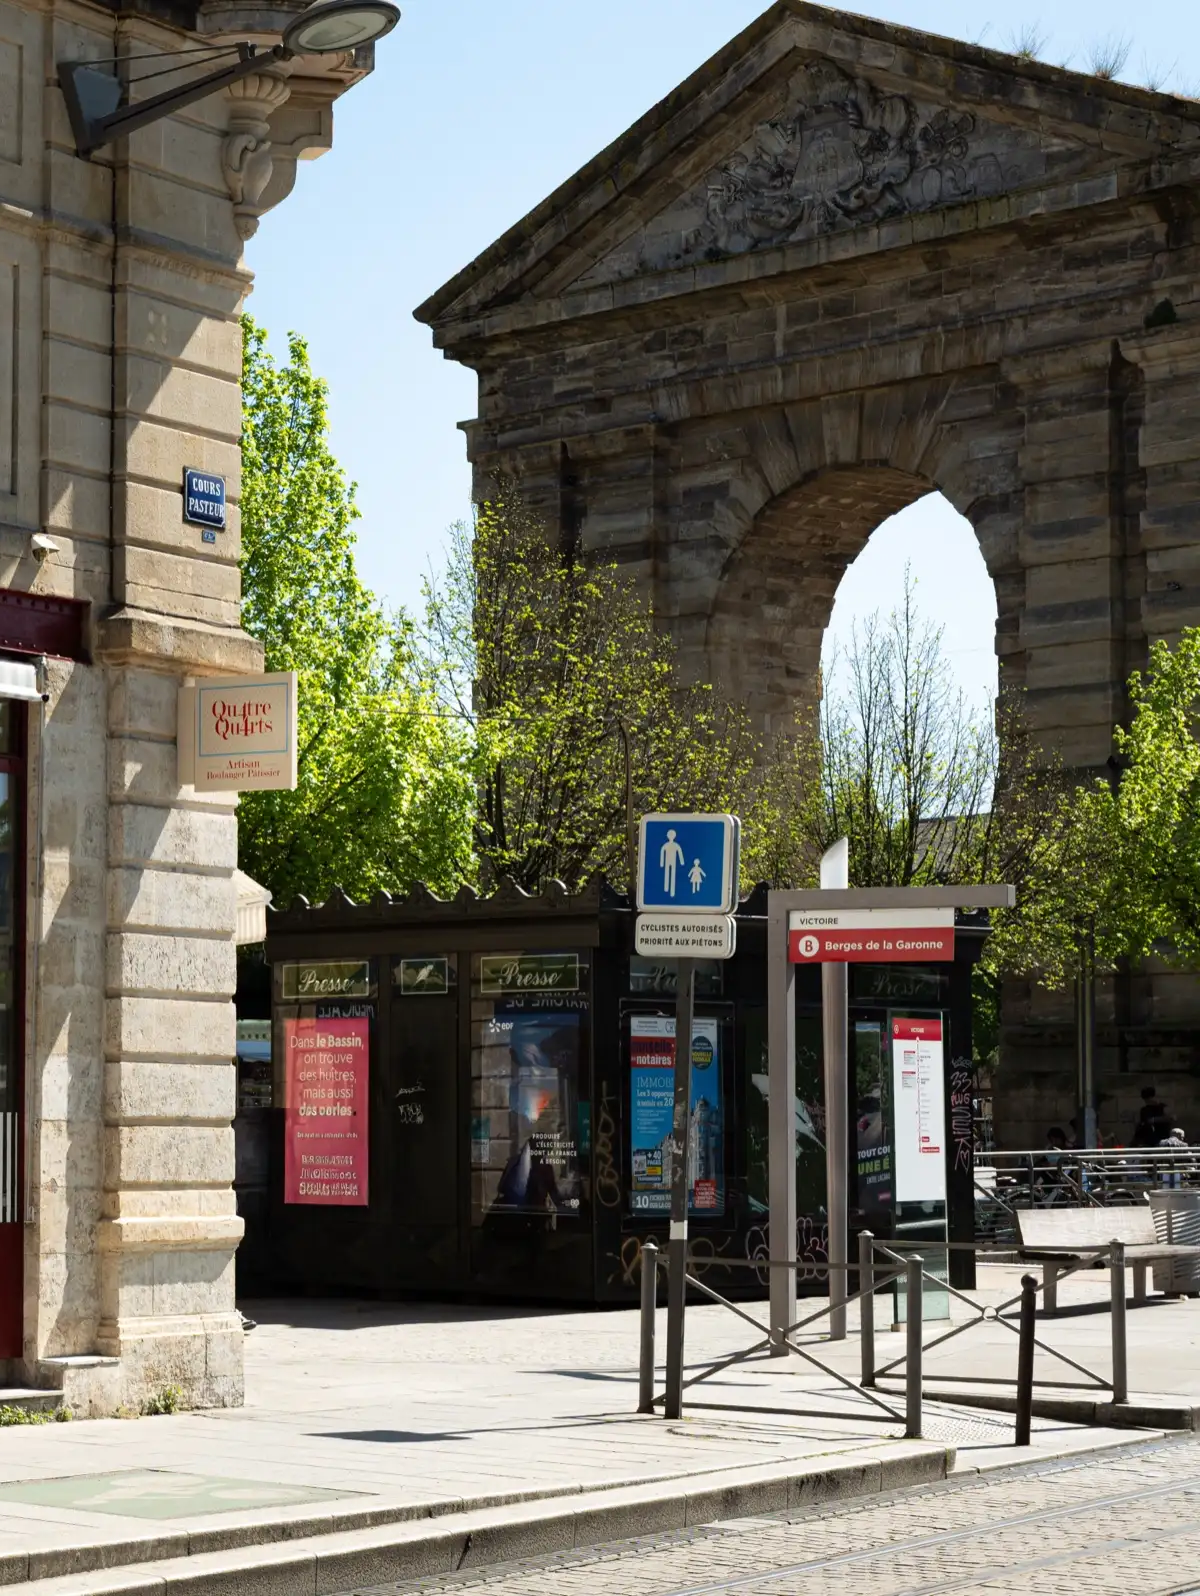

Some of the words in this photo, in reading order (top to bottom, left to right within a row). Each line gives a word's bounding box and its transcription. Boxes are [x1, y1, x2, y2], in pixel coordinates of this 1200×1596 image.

[192, 478, 221, 496] COURS
[188, 497, 224, 518] PASTEUR
[227, 759, 260, 770] Artisan
[207, 770, 245, 780] Boulanger
[800, 917, 839, 925] VICTOIRE
[640, 924, 680, 932] CYCLISTES
[681, 925, 723, 934] AUTORISÉS
[640, 937, 673, 946] PRIORITÉ
[691, 938, 723, 947] PIÉTONS
[825, 941, 863, 952] Berges
[865, 940, 880, 950] de
[883, 940, 893, 950] la
[896, 940, 943, 950] Garonne
[298, 969, 354, 992] Presse
[498, 961, 562, 987] Presse
[871, 971, 926, 995] Presse
[290, 1035, 314, 1048] Dans
[316, 1033, 326, 1048] le
[327, 1031, 364, 1050] Bassin,
[304, 1053, 316, 1064] on
[319, 1052, 353, 1064] trouve
[636, 1054, 672, 1065] notaires
[299, 1068, 317, 1081] des
[319, 1067, 357, 1083] huîtres,
[303, 1084, 326, 1099] mais
[327, 1085, 354, 1099] aussi
[299, 1102, 317, 1116] des
[858, 1148, 877, 1159] TOUT
[858, 1159, 881, 1175] UNE
[636, 1195, 648, 1208] 10
